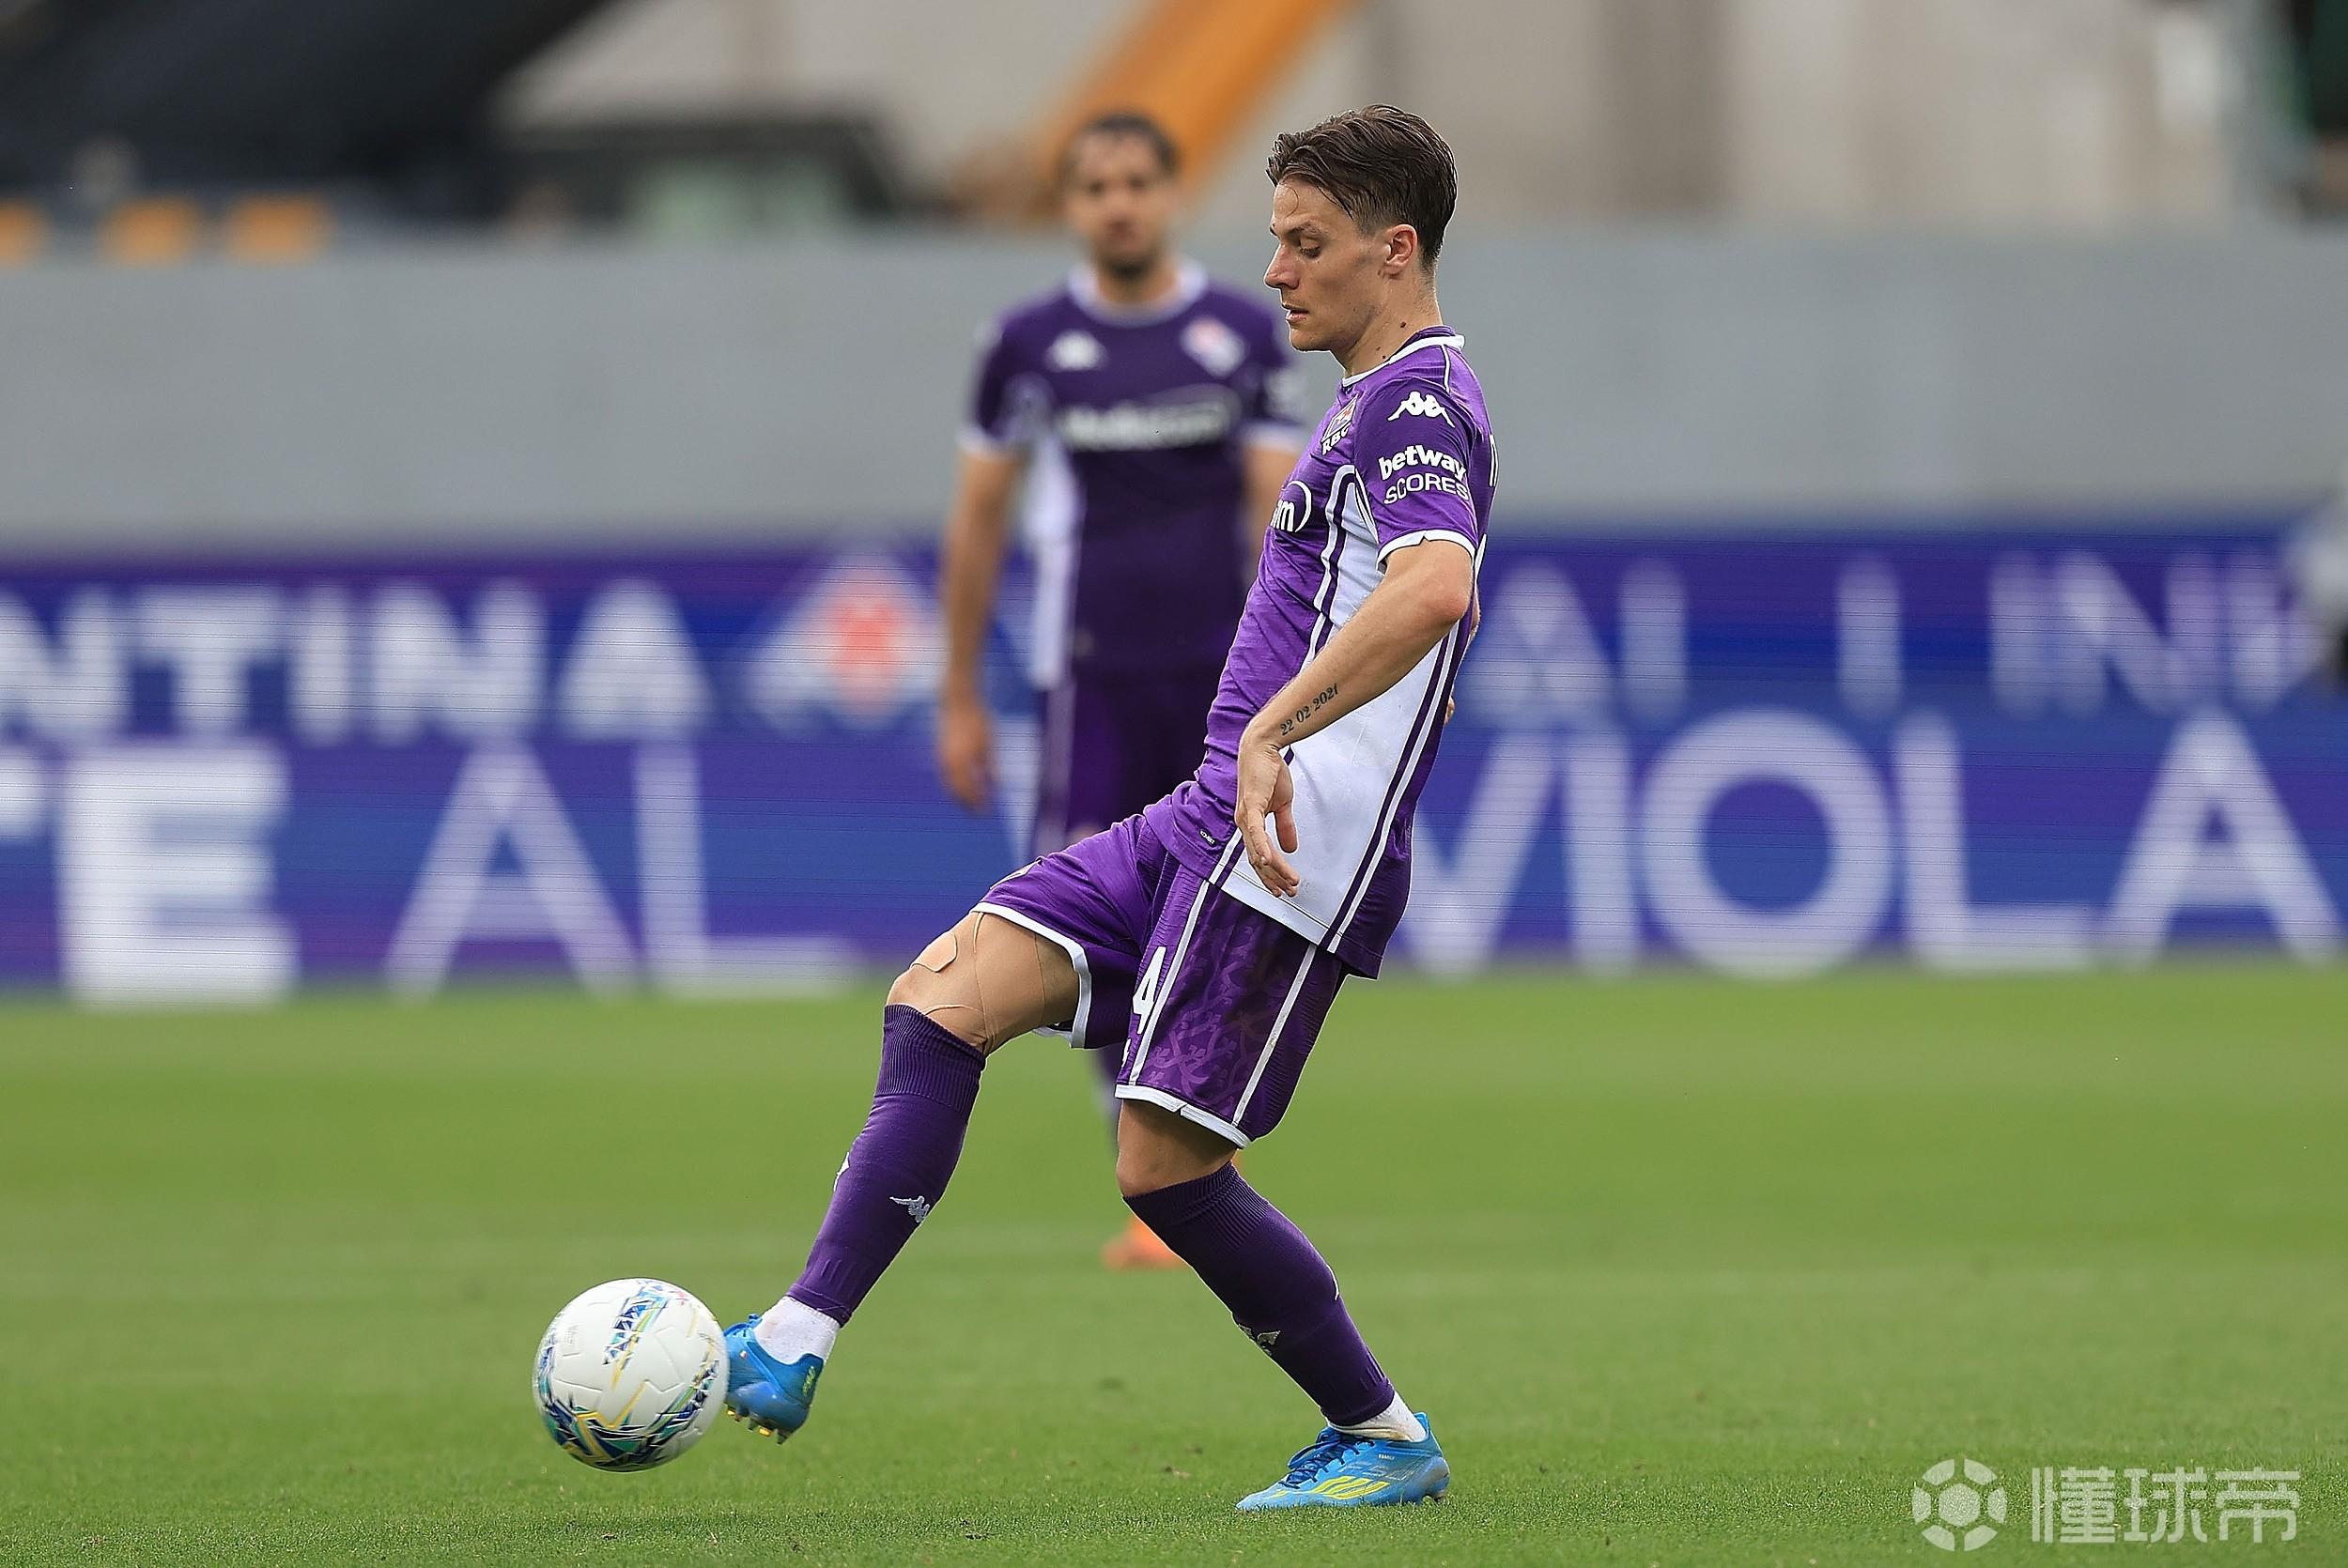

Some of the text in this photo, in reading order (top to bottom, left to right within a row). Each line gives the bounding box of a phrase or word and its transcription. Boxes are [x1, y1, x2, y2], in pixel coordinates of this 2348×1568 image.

[1378, 445, 1466, 481] betway
[1383, 472, 1469, 504] SCORES
[1280, 719, 1295, 736] 22
[1313, 684, 1338, 712] 2021
[387, 737, 857, 1001] AL
[1133, 946, 1166, 1034] 4
